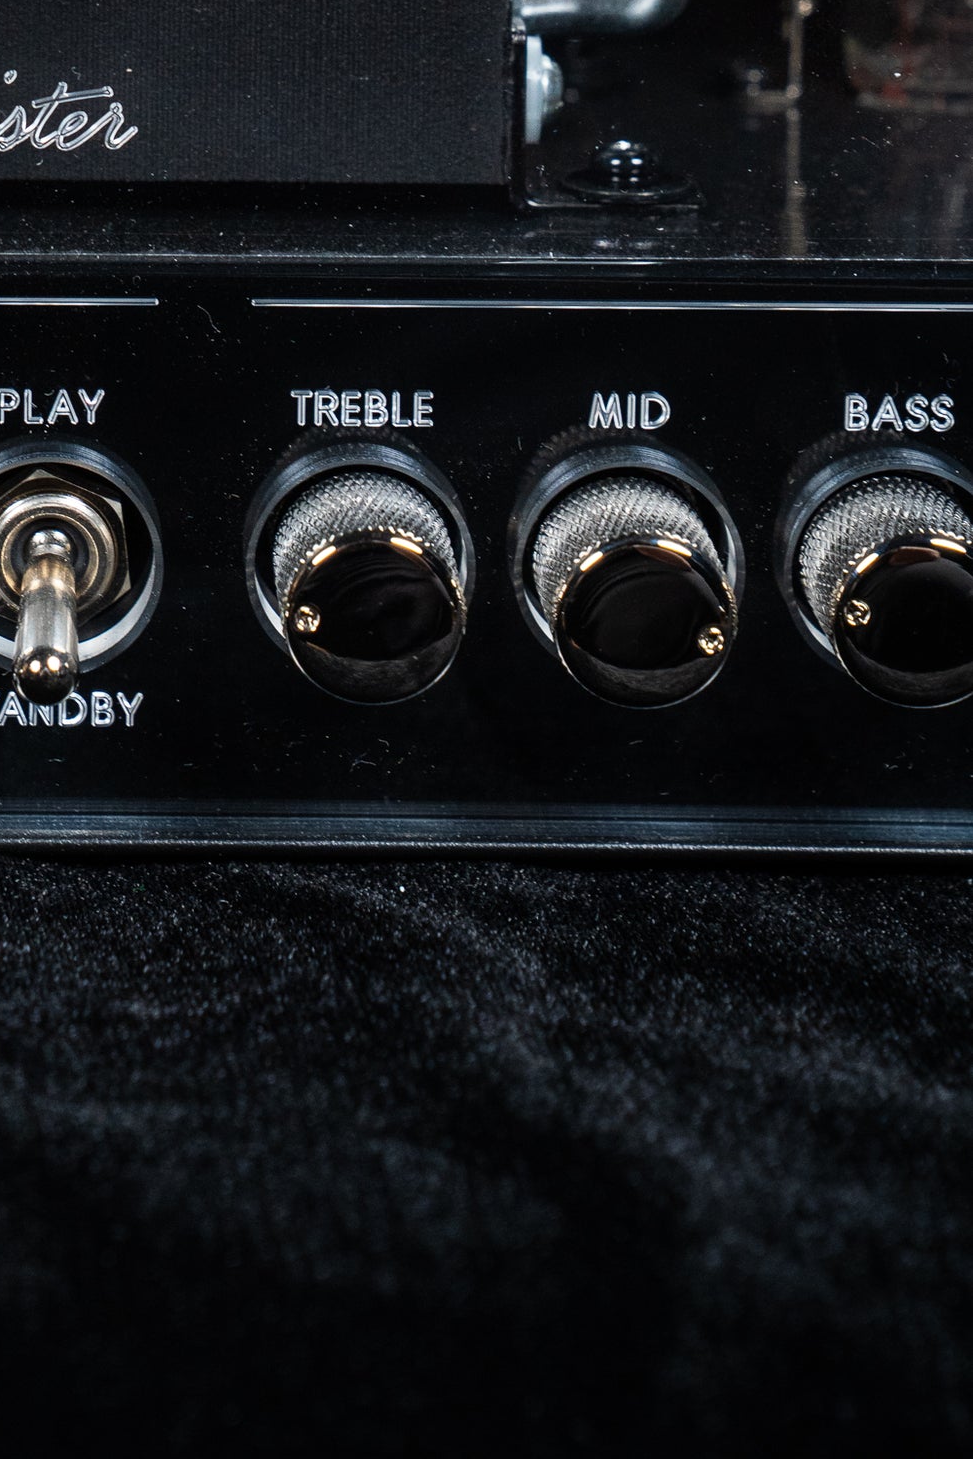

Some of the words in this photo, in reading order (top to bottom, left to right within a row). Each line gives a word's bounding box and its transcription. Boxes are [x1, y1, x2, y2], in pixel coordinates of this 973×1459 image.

[290, 389, 435, 428] TREBLE
[588, 391, 672, 430] MID
[843, 392, 955, 433] BASS
